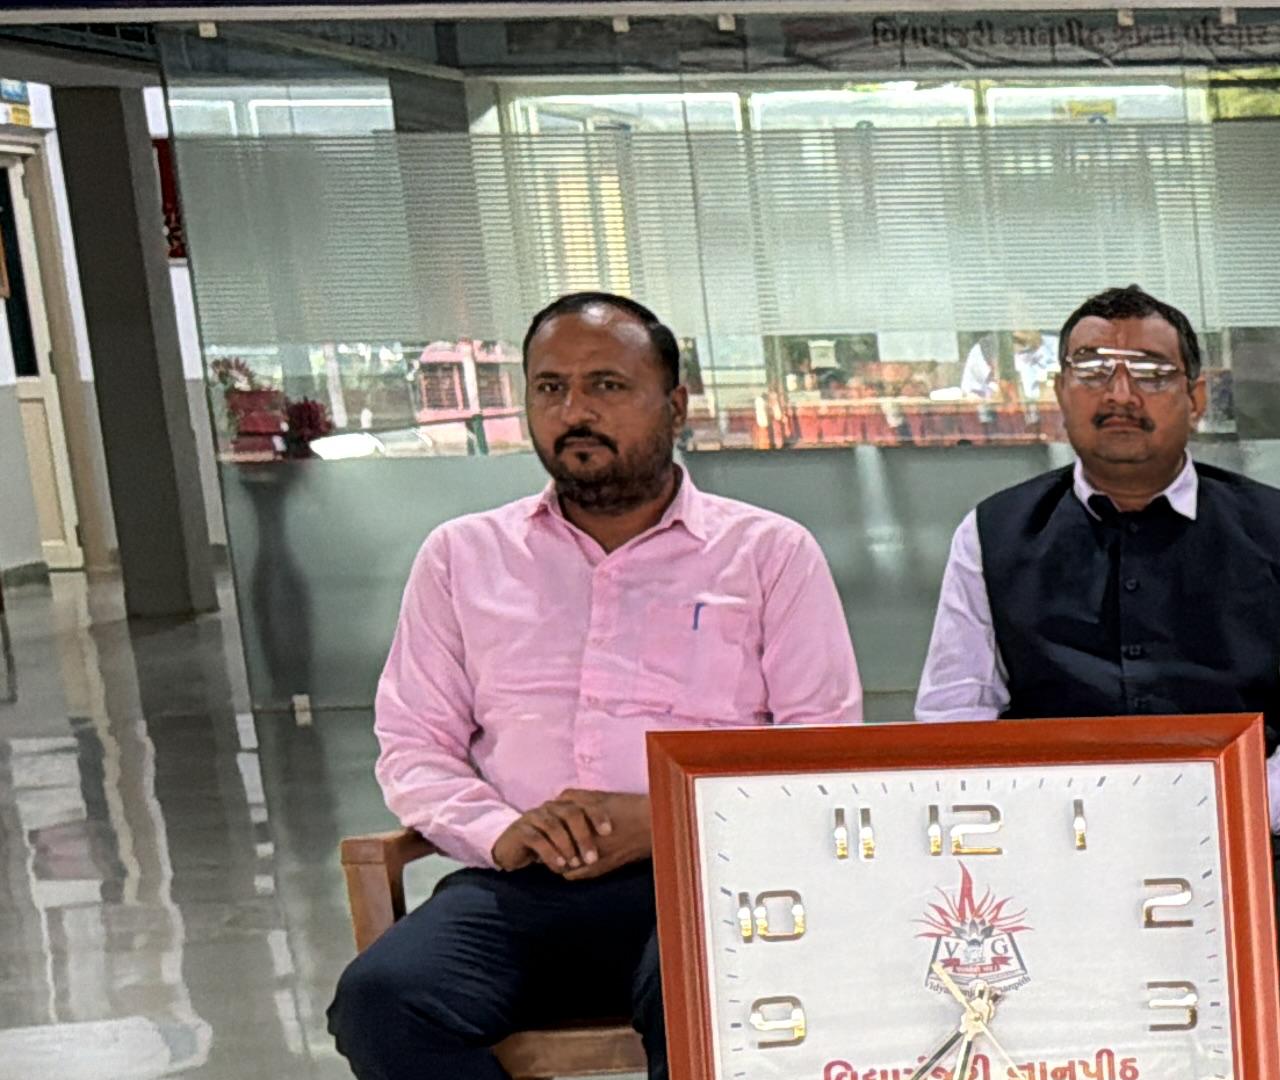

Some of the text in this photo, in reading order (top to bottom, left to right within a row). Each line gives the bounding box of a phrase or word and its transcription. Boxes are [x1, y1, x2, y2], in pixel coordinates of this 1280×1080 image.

[834, 807, 875, 859] 11
[927, 804, 1003, 856] 12
[1073, 799, 1087, 850] 1
[738, 890, 806, 943] 10
[1142, 878, 1194, 929] 2
[944, 938, 1009, 957] V G
[749, 995, 808, 1049] 9
[1145, 981, 1198, 1032] 3
